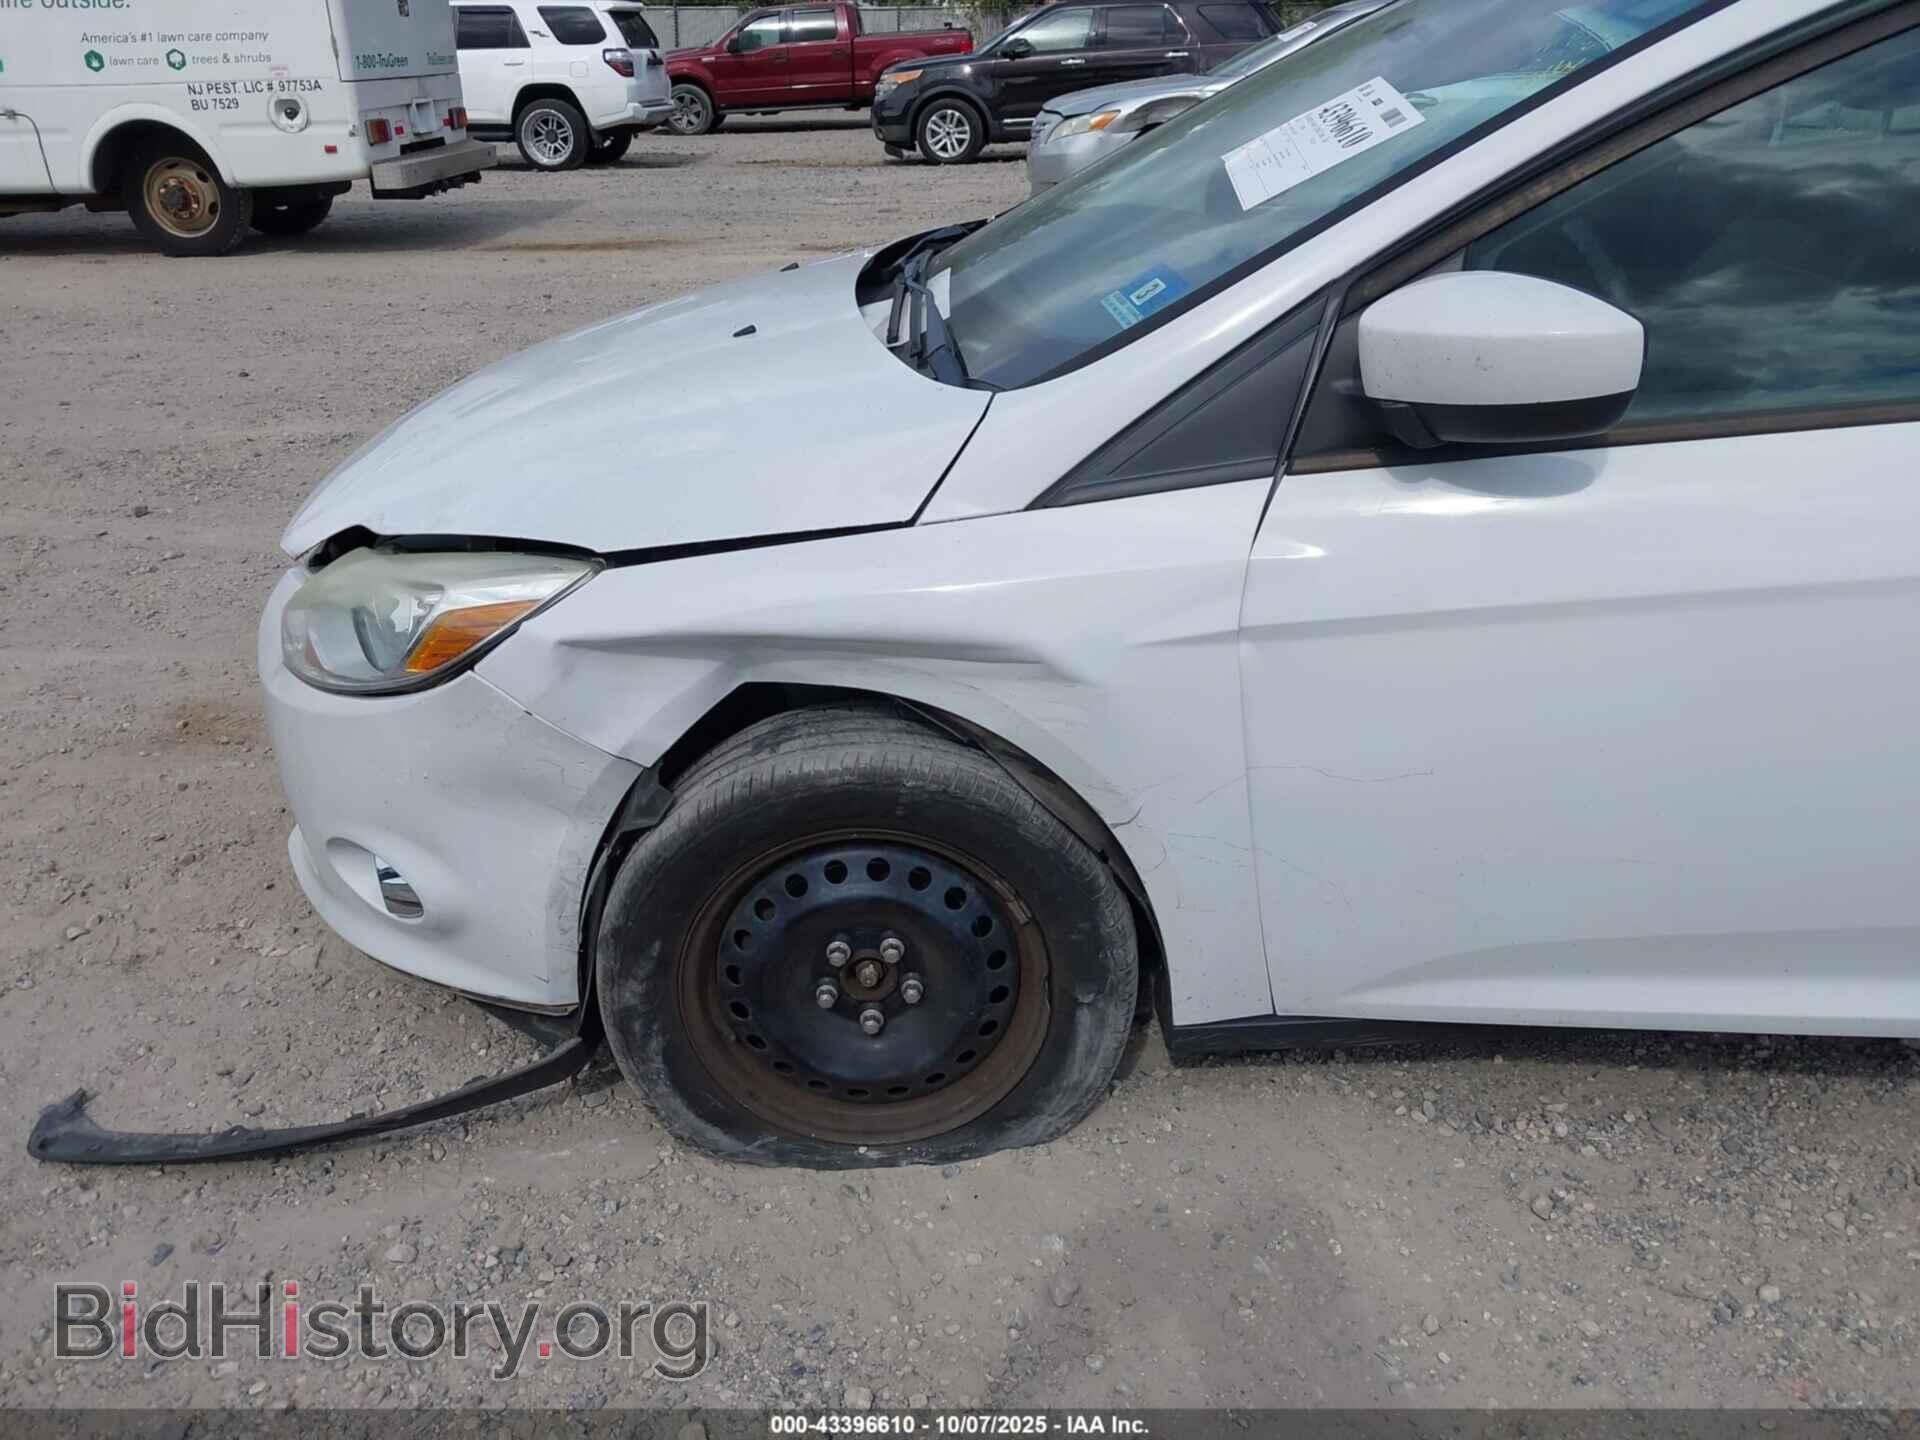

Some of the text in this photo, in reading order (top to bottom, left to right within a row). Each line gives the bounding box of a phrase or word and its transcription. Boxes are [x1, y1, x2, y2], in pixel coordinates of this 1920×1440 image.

[81, 32, 269, 44] America's #1 lawn care company
[109, 56, 159, 66] lawn care
[192, 52, 271, 64] trees & shrubs
[187, 84, 203, 95] NJ
[244, 81, 264, 94] LIC
[267, 82, 274, 92] #
[278, 80, 322, 92] 97753A
[191, 98, 239, 111] BU 7529
